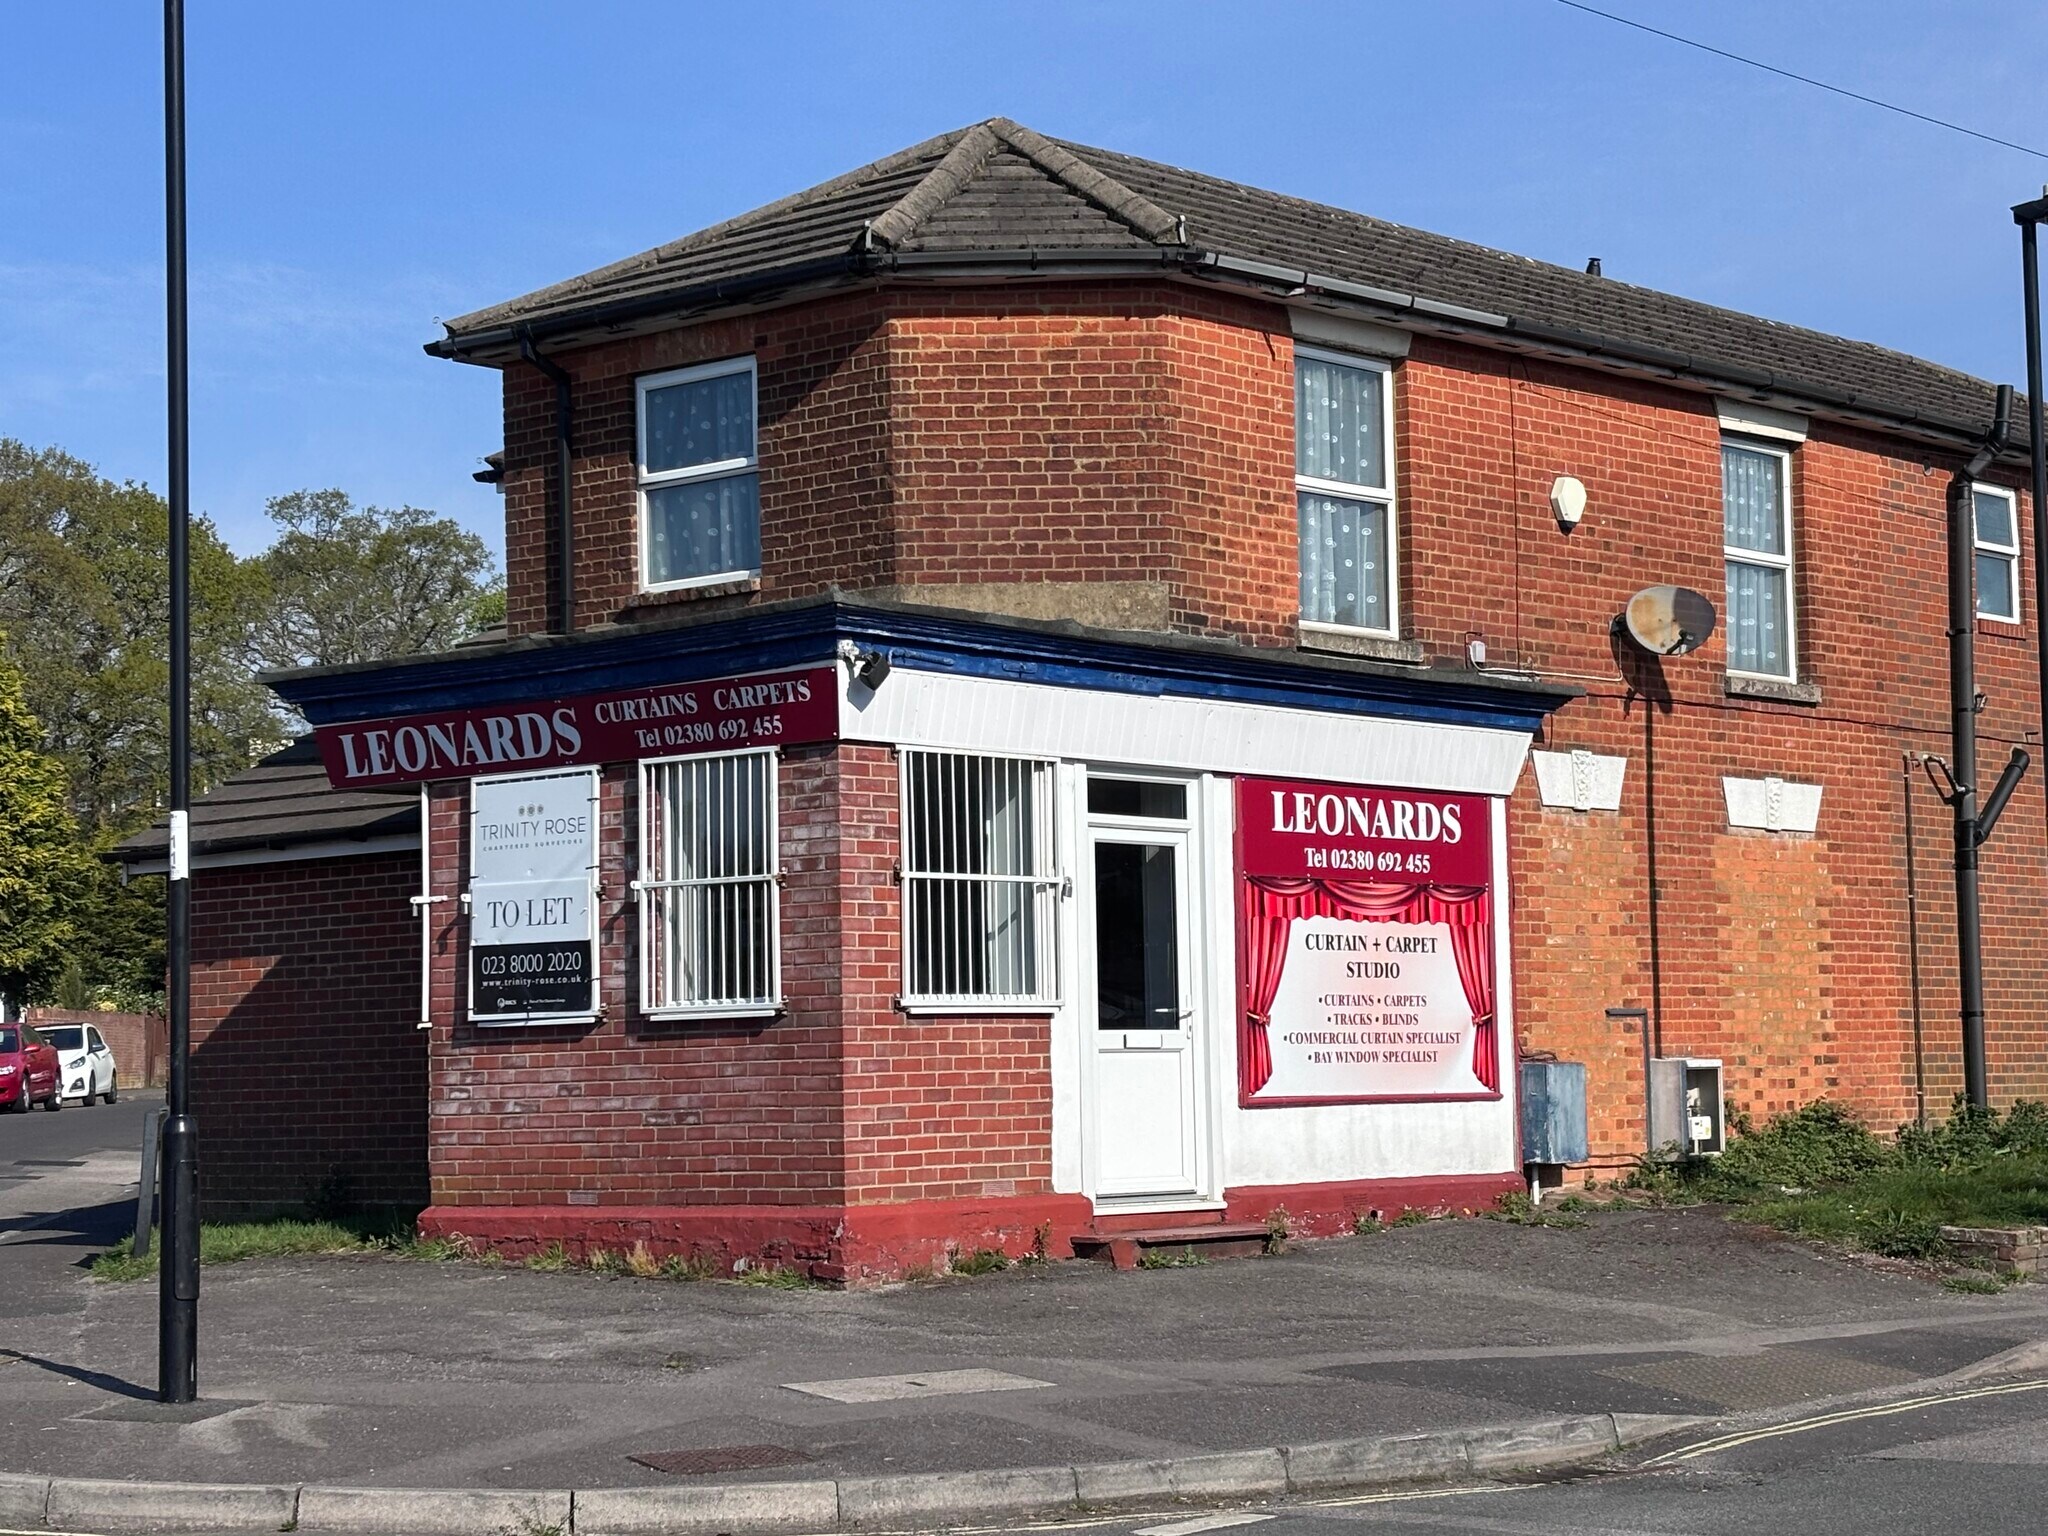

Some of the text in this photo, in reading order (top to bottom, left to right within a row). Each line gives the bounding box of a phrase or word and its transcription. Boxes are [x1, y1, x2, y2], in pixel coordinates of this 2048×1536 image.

[594, 679, 812, 724] CURTAINS CARPETS
[635, 715, 783, 748] Tel 02380 692 455
[338, 707, 582, 778] LEONARDS
[1270, 790, 1462, 844] LEONARDS
[480, 816, 586, 840] TRINITY ROSE
[483, 838, 583, 852] CHARTERED SURVEYORS
[1304, 847, 1431, 874] Tel 02380 692 455
[487, 897, 573, 928] TO LET
[1305, 934, 1368, 951] CURTAIN
[1386, 936, 1438, 953] CARPET
[481, 951, 582, 974] 023 8000 2020
[1346, 961, 1400, 979] STUDIO
[482, 974, 582, 987] www.trinity-rose.co.uk
[1324, 994, 1427, 1007] CURTAINS CARPETS
[1333, 1013, 1419, 1026] TRACKS BLINDS
[1289, 1032, 1461, 1044] COMMERCIAL CURTAIN SPECIALIST
[1314, 1051, 1438, 1063] BAY WINDOW SPECIALIST
